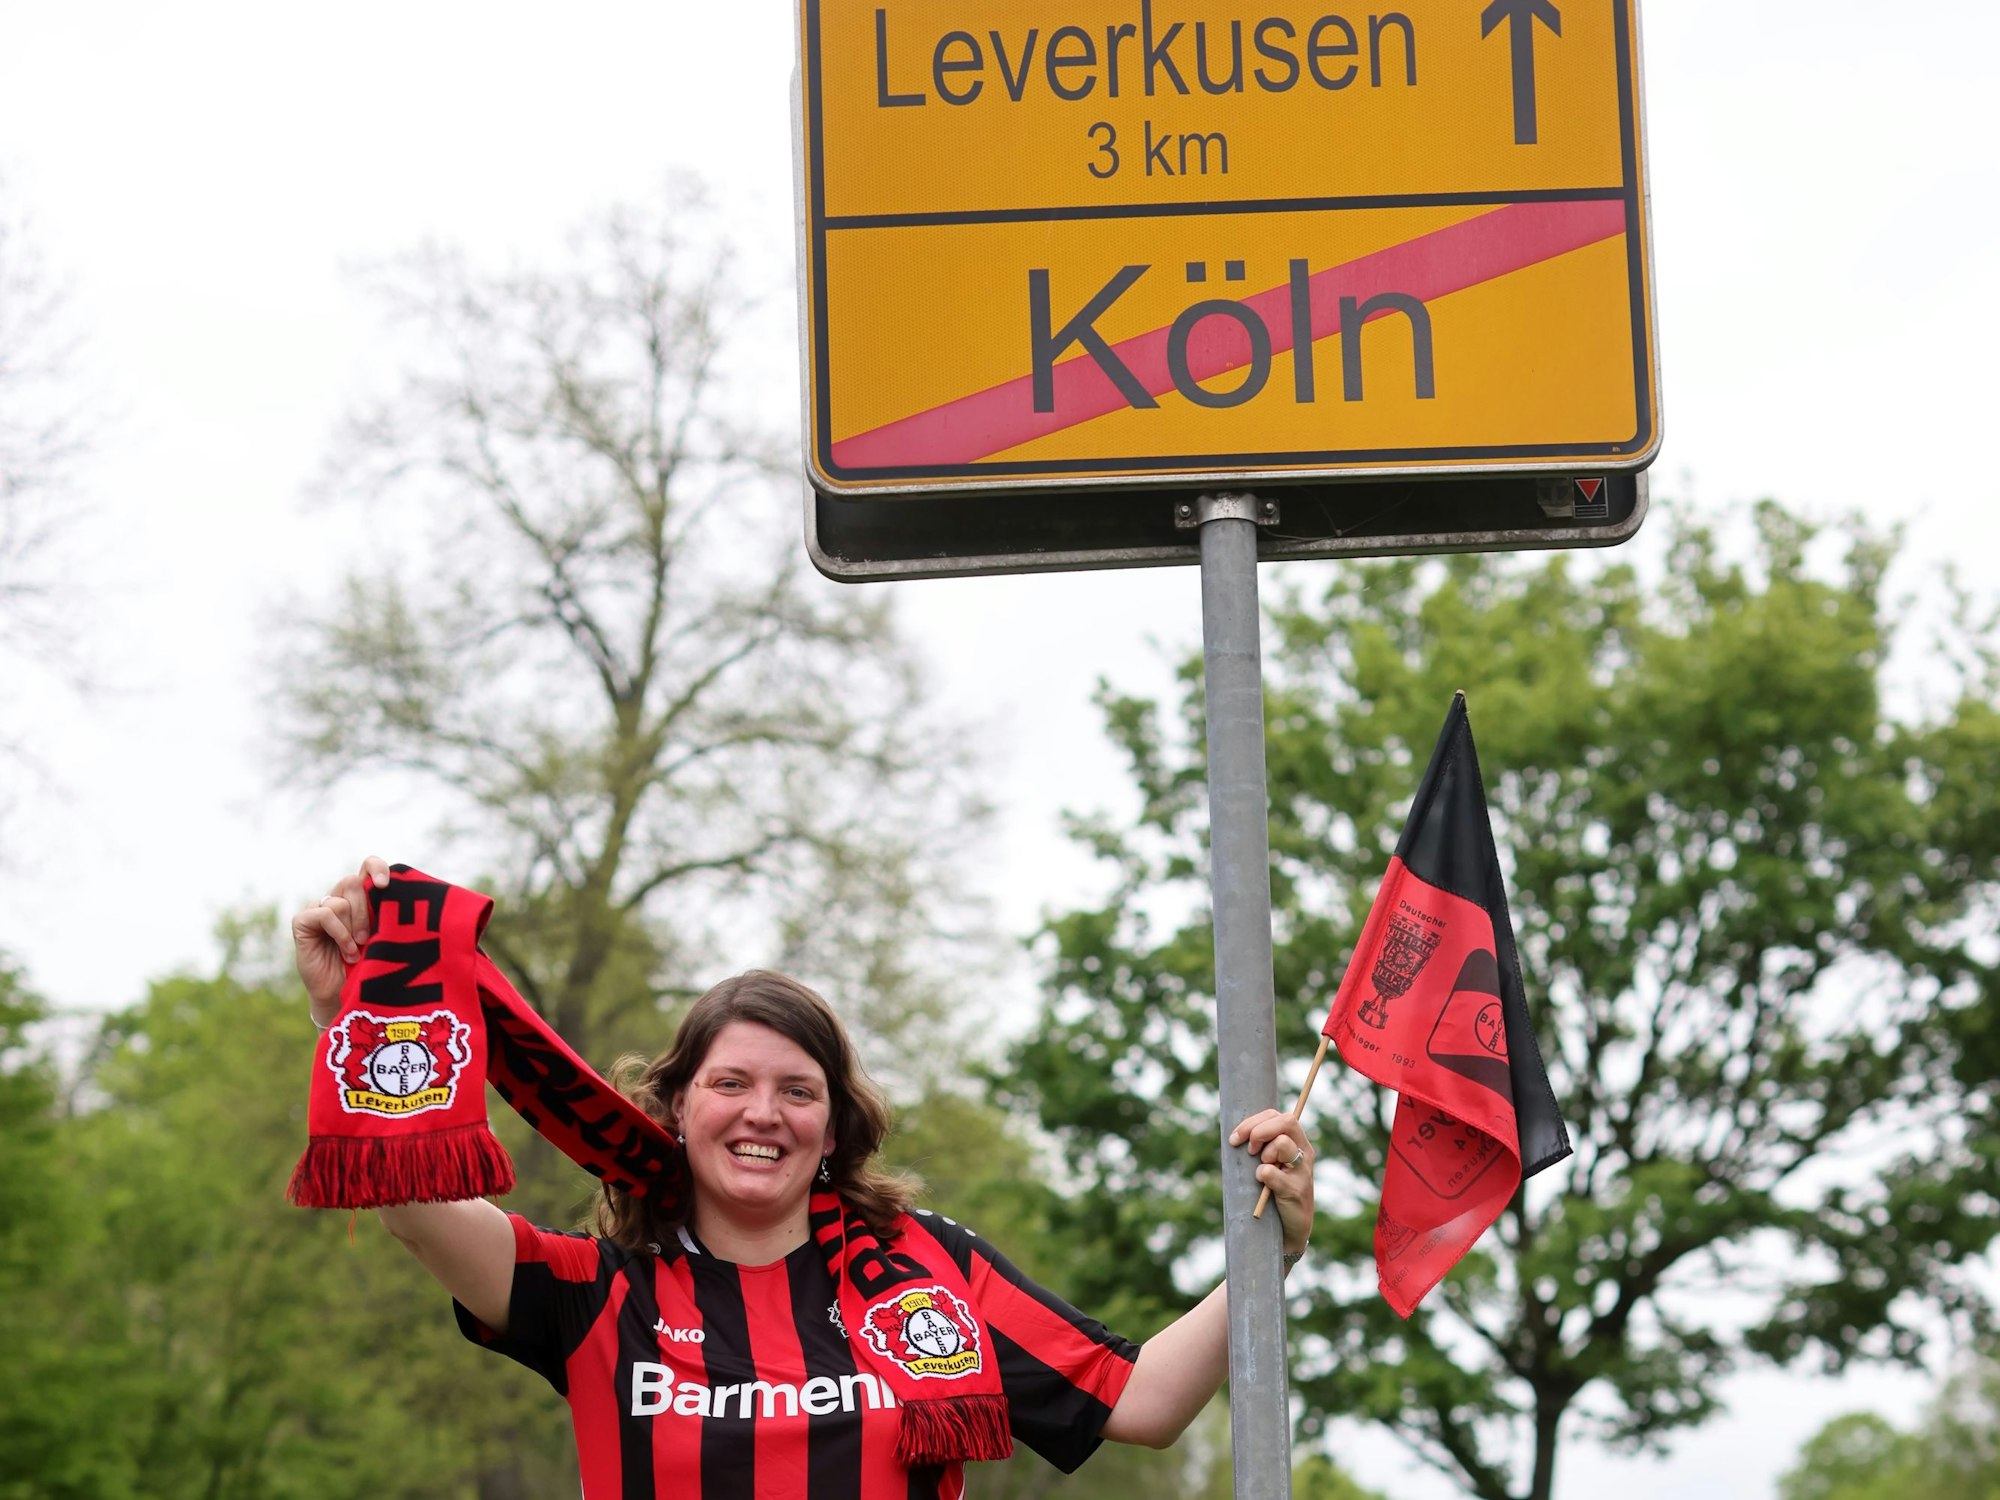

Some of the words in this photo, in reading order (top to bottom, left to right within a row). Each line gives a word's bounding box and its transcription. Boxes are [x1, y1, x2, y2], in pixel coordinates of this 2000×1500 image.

[875, 0, 1417, 108] Leverkusen
[1086, 121, 1121, 179] 3
[1143, 120, 1230, 177] km
[1029, 257, 1437, 414] Köln
[1399, 900, 1447, 929] Deutscher
[390, 1027, 417, 1039] 1904
[376, 1062, 427, 1075] BAYER
[398, 1044, 411, 1095] BAYER
[1391, 1053, 1416, 1069] 1993
[355, 1091, 443, 1111] Leverkusen
[904, 1296, 930, 1310] 1904
[653, 1317, 705, 1344] JAKO
[913, 1325, 955, 1342] BAYER
[921, 1311, 948, 1355] BAYER
[913, 1355, 976, 1372] Leverkusen
